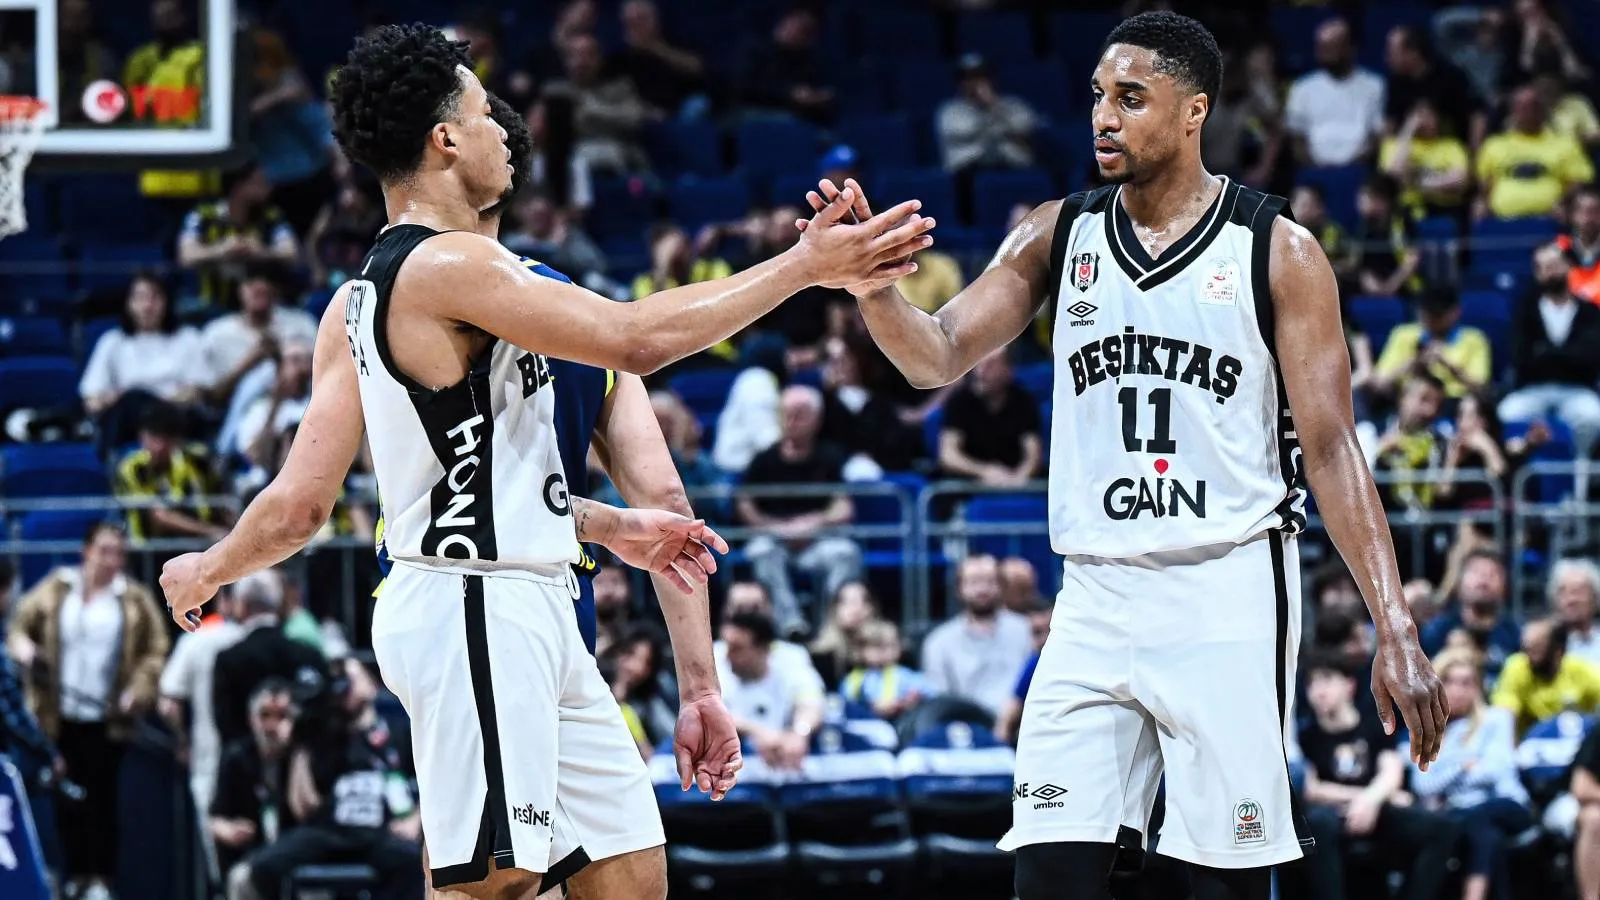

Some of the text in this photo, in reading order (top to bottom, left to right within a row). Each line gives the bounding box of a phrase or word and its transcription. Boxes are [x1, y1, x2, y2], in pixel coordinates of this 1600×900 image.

[1070, 319, 1095, 327] umbro
[1068, 326, 1242, 405] BEŞİKTAŞ
[1118, 387, 1176, 454] 11
[1034, 801, 1065, 809] umbro
